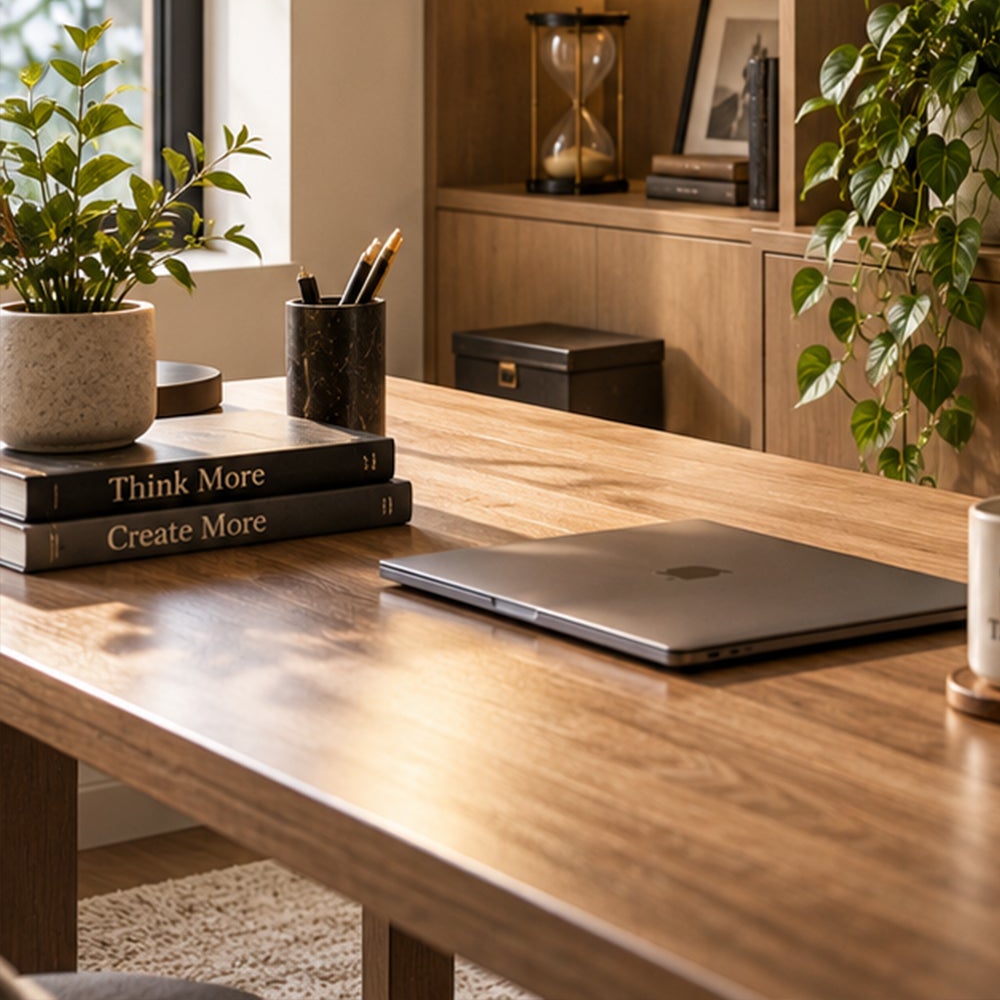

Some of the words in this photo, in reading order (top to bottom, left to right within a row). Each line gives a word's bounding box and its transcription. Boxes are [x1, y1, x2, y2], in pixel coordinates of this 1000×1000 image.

[107, 468, 189, 502] Think
[198, 464, 266, 493] More
[107, 521, 193, 552] Create
[200, 511, 267, 541] More
